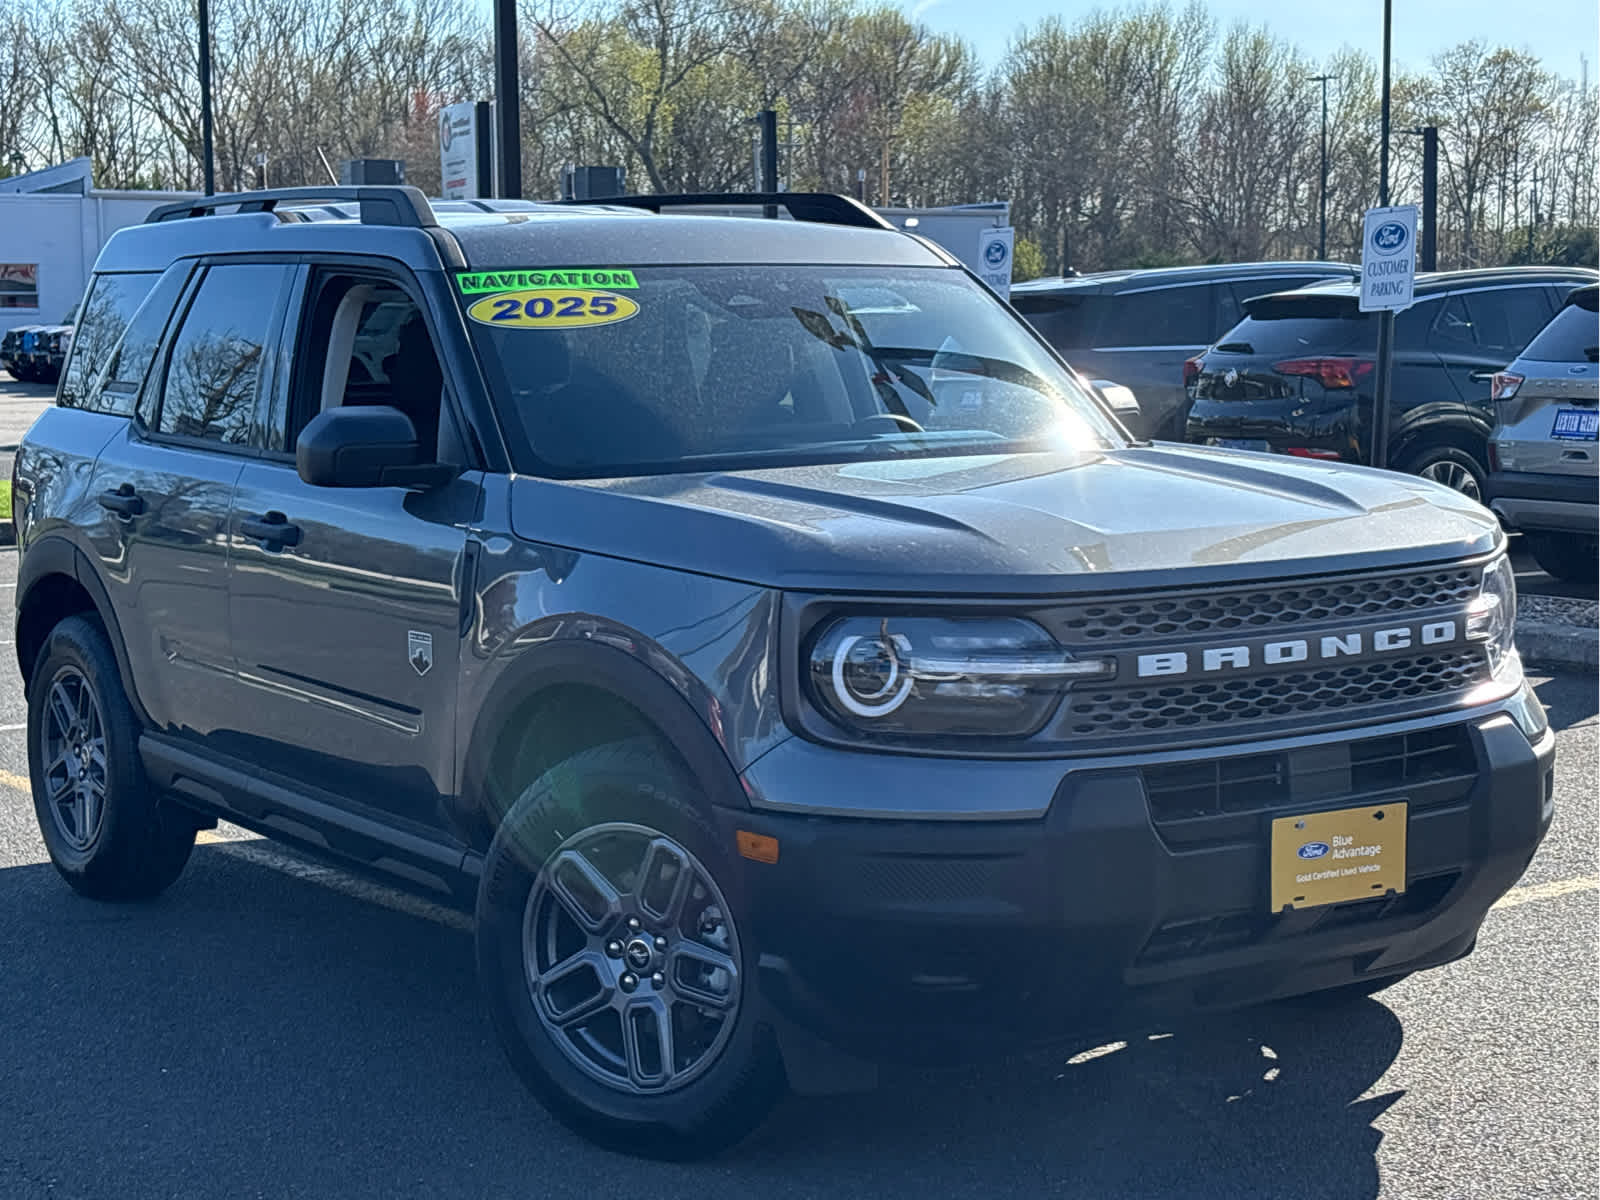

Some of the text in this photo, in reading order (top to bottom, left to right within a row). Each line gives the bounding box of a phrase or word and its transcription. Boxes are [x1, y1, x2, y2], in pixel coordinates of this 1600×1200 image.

[1368, 259, 1409, 277] CUSTOMER
[462, 273, 631, 289] NAVIGATION
[1371, 280, 1404, 296] PARKING
[491, 296, 617, 321] 2025
[1137, 621, 1456, 677] BRONCO
[1332, 835, 1353, 847] Blue
[1332, 845, 1381, 860] Advantage
[1296, 864, 1380, 883] Gold Certified Used Vehicle
